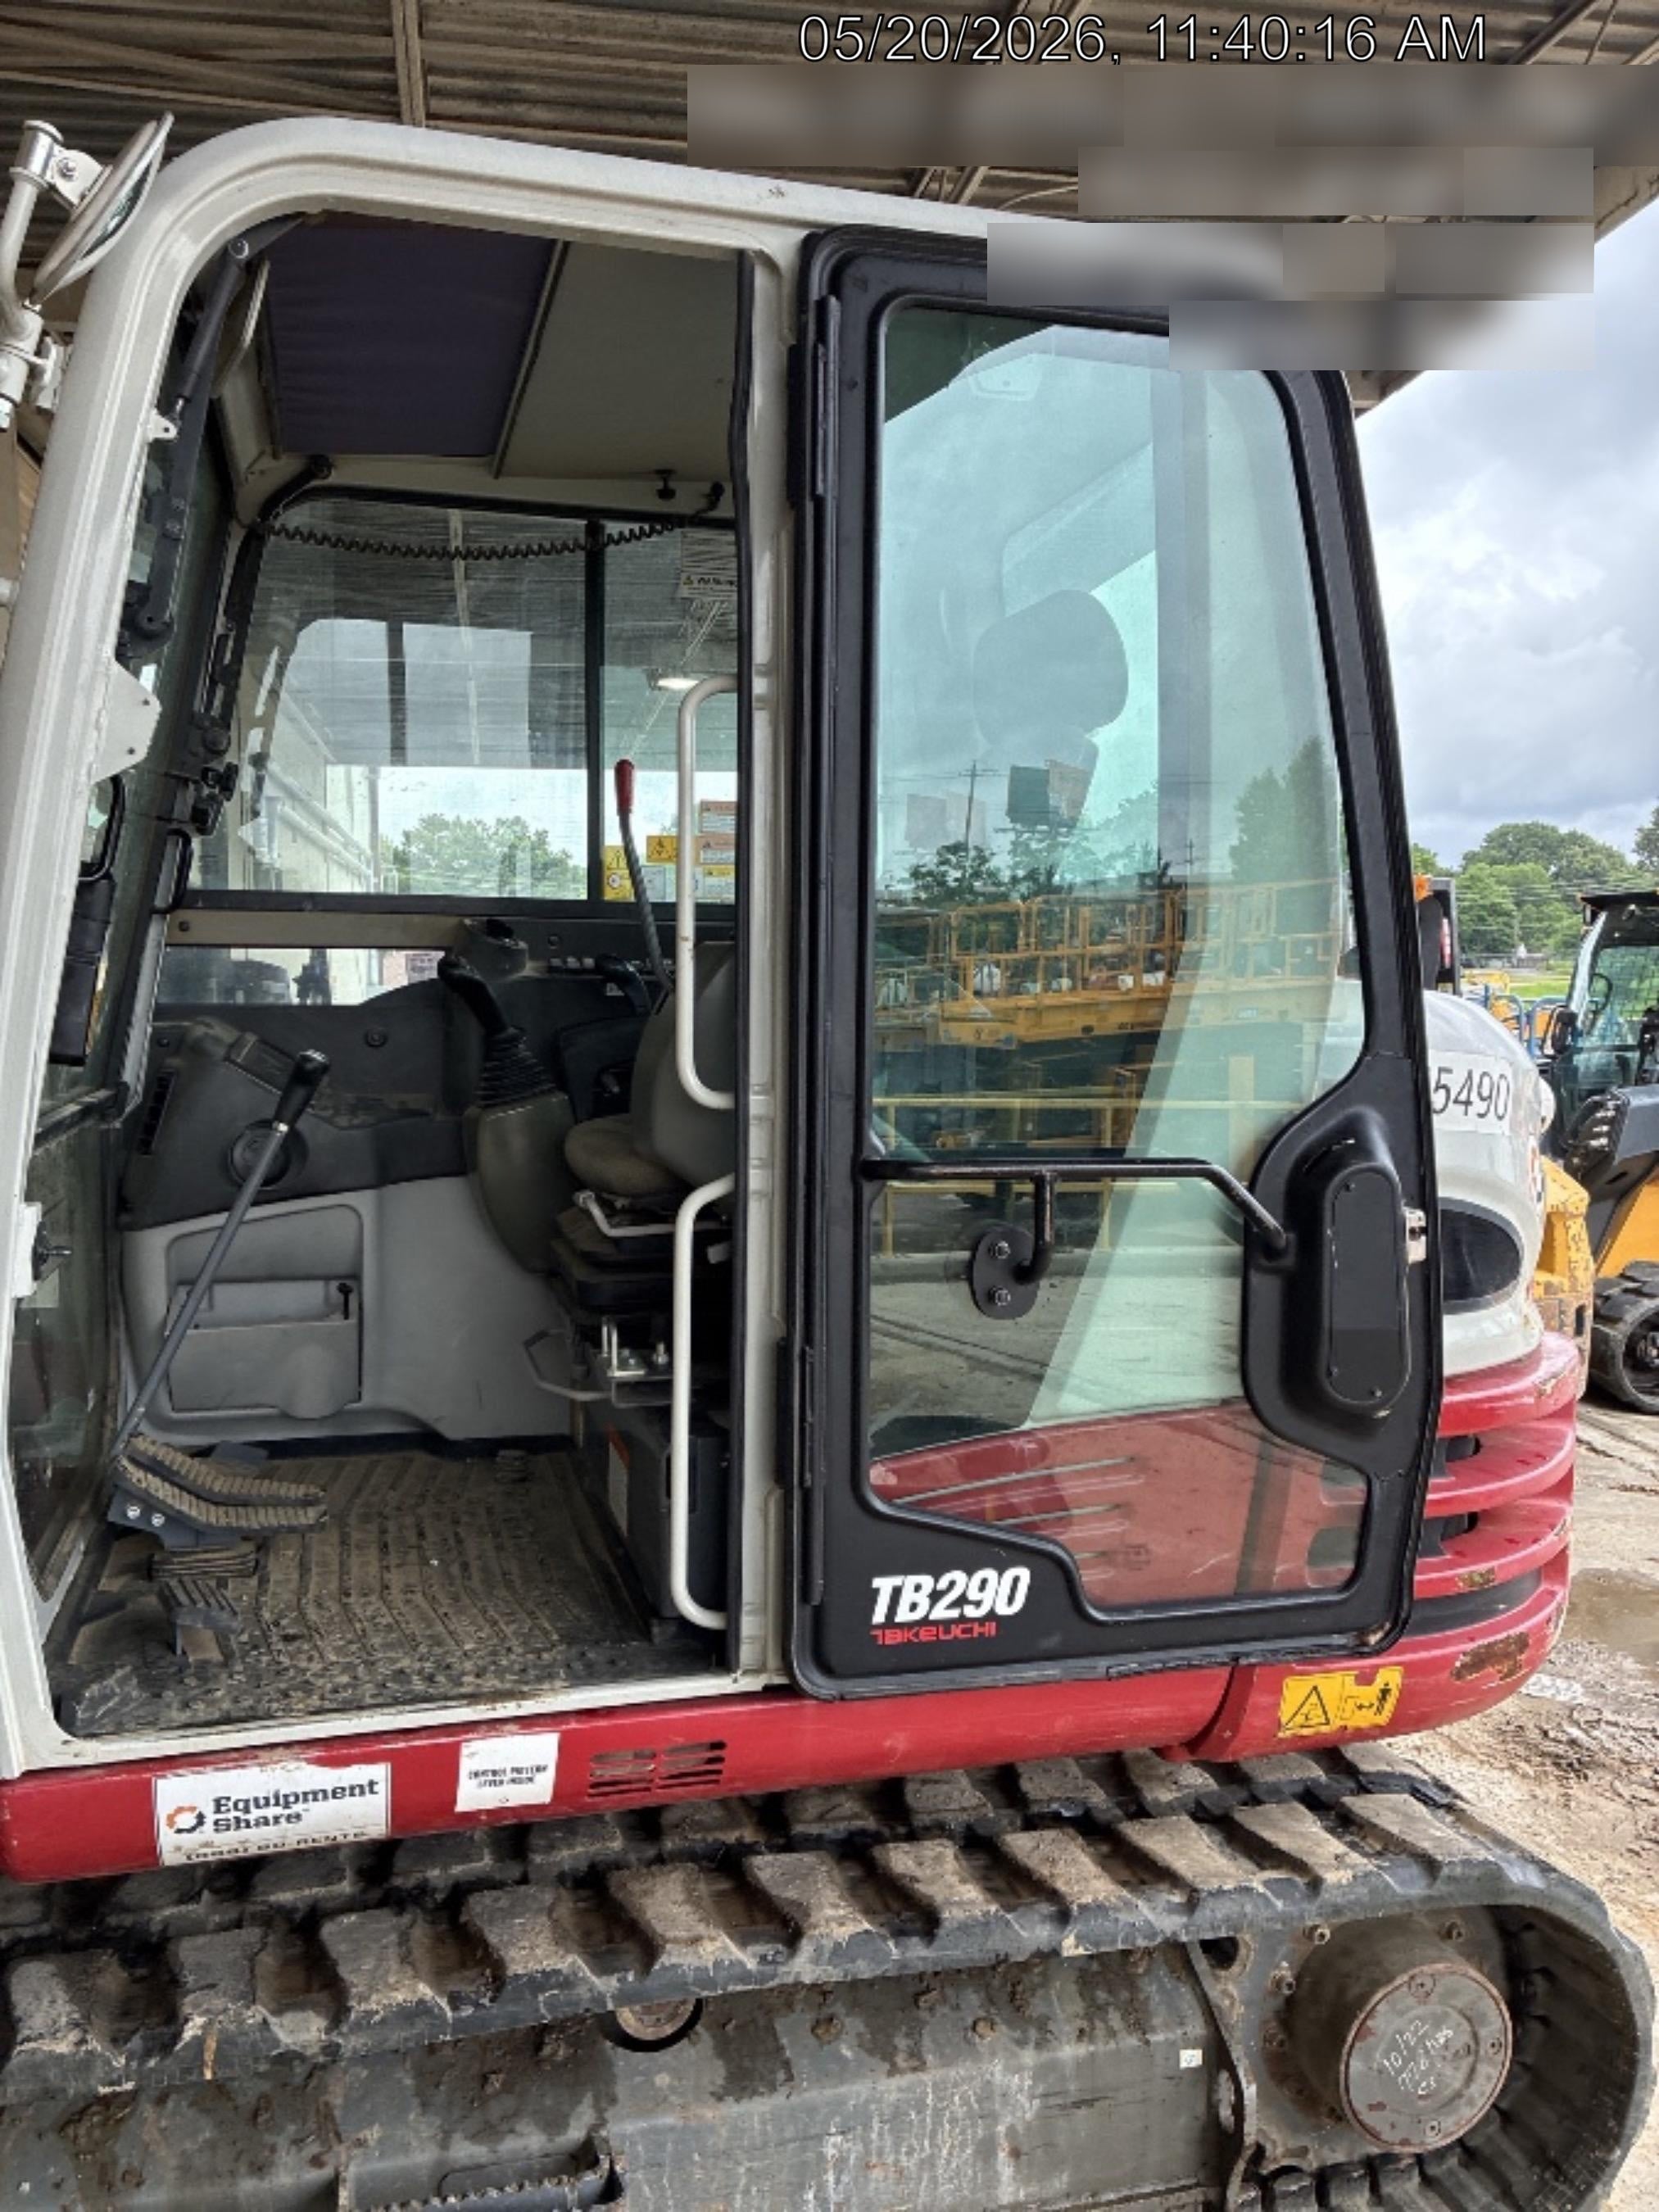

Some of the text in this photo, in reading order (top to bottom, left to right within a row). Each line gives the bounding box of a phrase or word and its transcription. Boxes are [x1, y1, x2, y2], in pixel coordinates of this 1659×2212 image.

[1432, 1066, 1511, 1121] 5490
[871, 1566, 1031, 1625] TB290
[870, 1621, 997, 1646] TAKEUCHI
[212, 1778, 379, 1815] Equipment
[212, 1810, 303, 1834] Share
